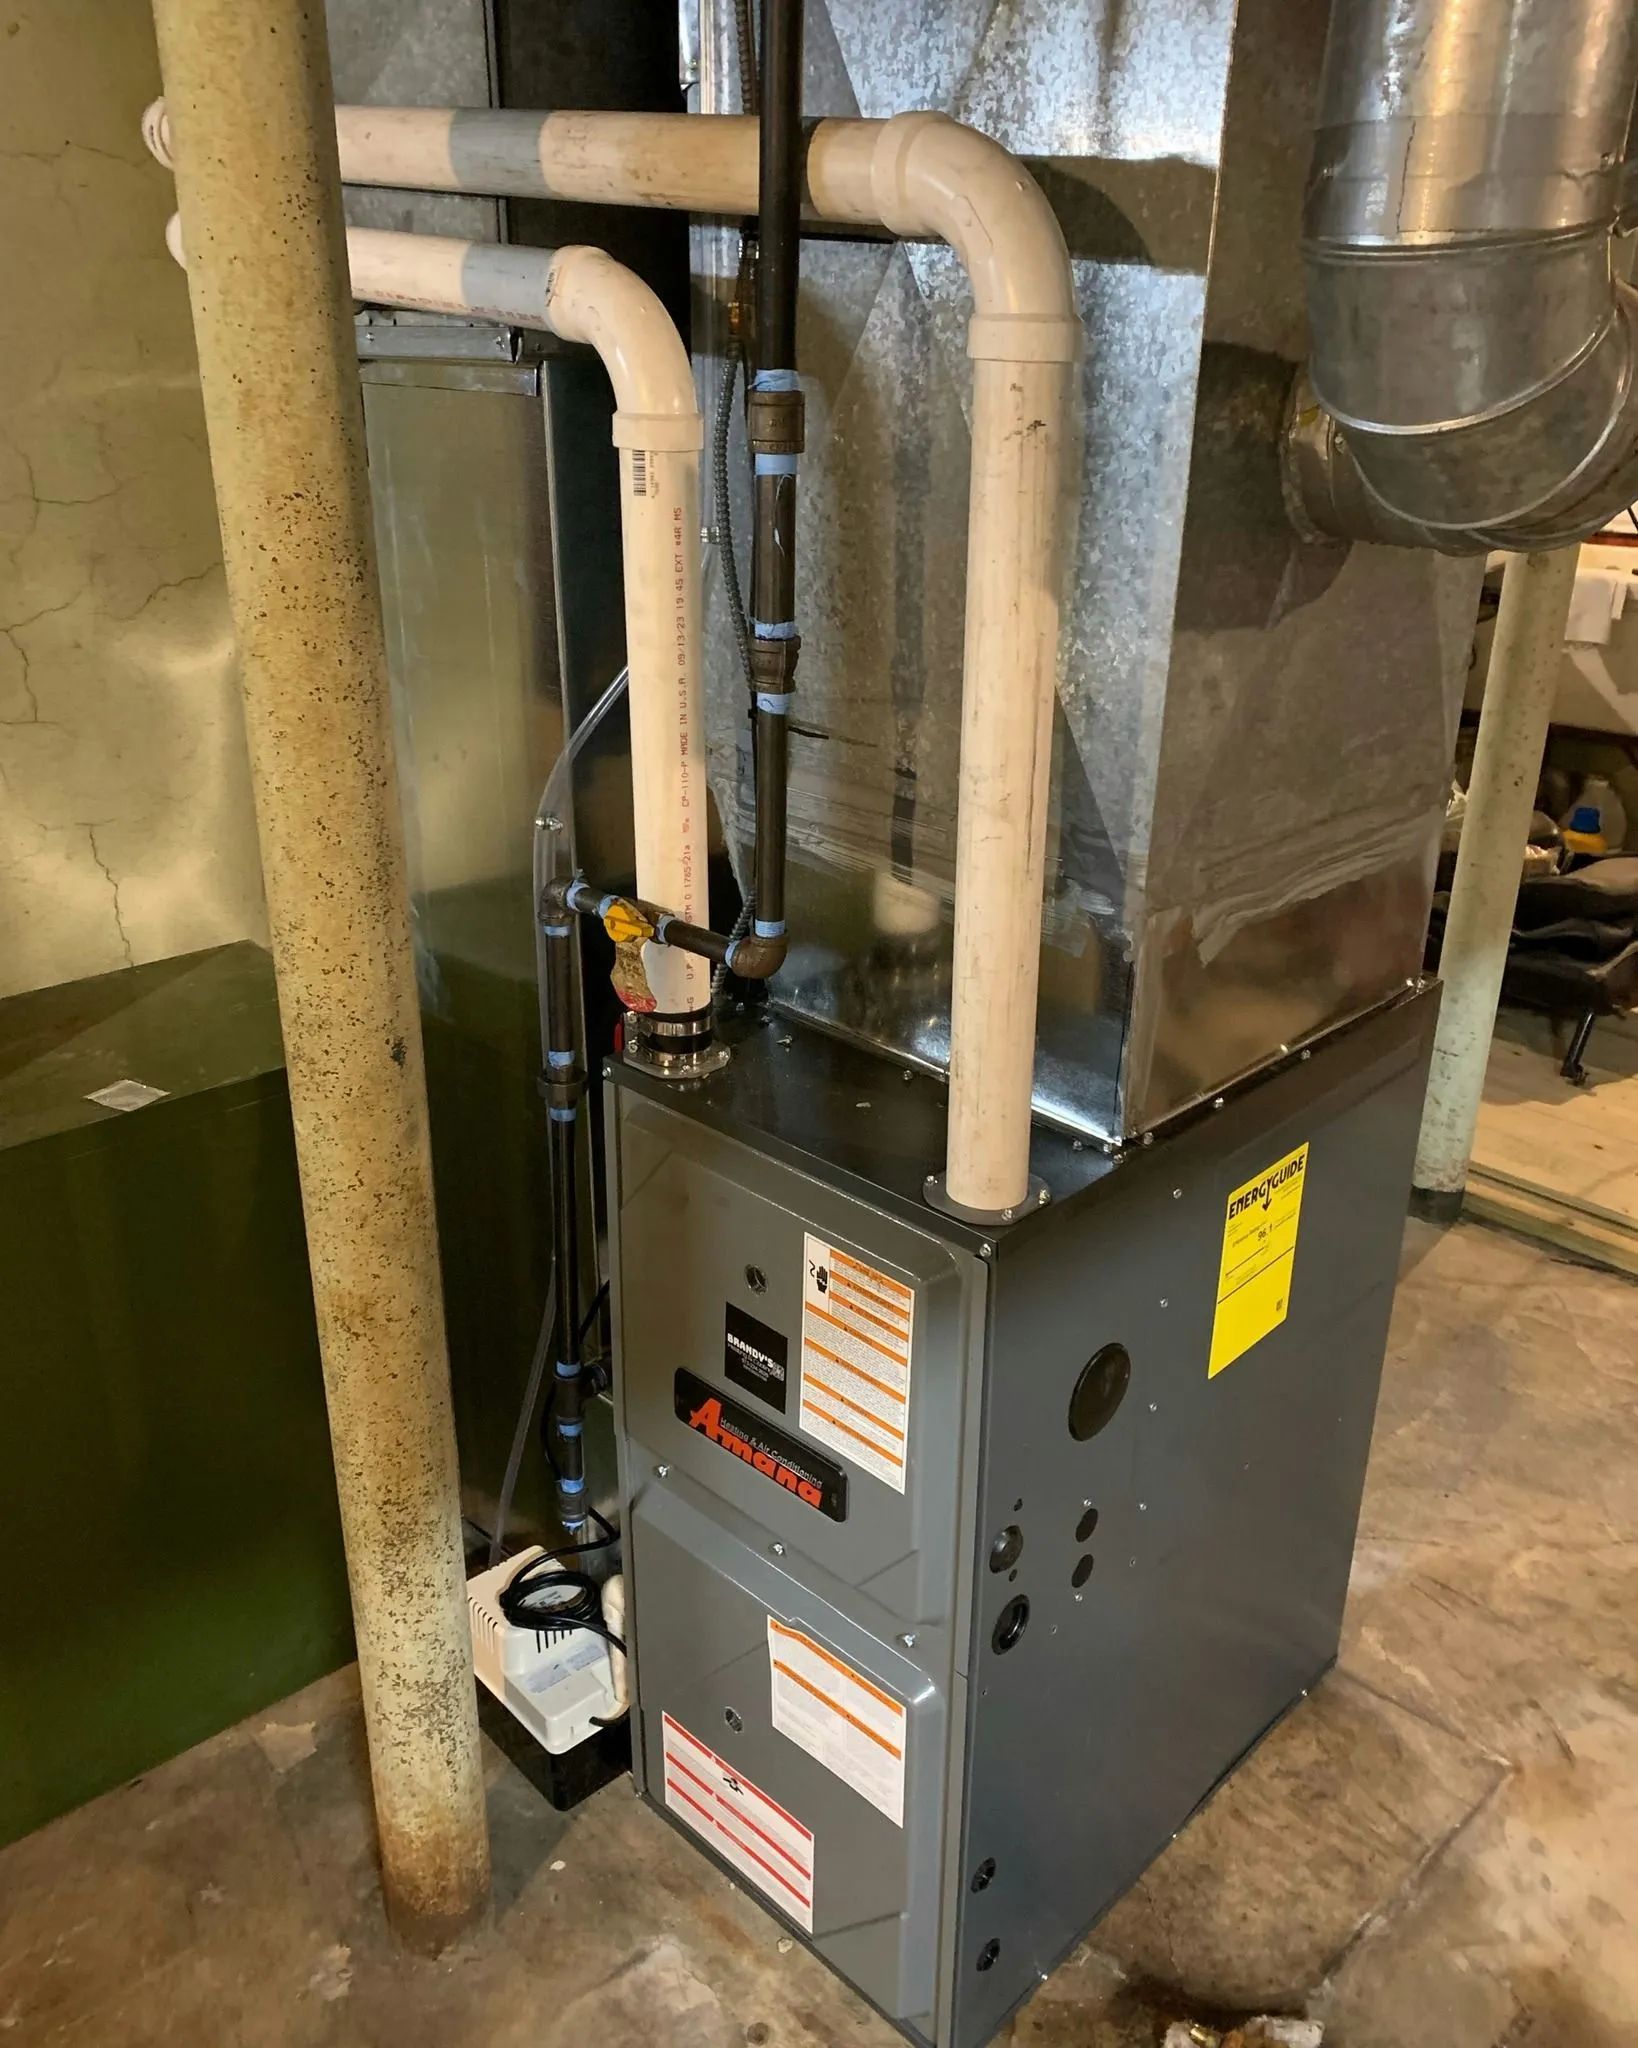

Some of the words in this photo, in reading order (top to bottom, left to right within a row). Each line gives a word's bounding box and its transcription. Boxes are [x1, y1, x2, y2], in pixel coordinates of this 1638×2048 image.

[673, 507, 682, 521] MS
[675, 554, 684, 573] EXT
[677, 616, 686, 666] 09/13/23
[680, 713, 688, 726] IN
[680, 731, 689, 756] MADE
[684, 904, 693, 924] STM
[727, 1332, 774, 1368] BRANDY'S
[688, 1397, 823, 1508] Amana
[720, 1416, 749, 1442] Heating
[750, 1437, 757, 1448] &
[758, 1441, 770, 1454] Air
[771, 1449, 823, 1489] Conditioning
